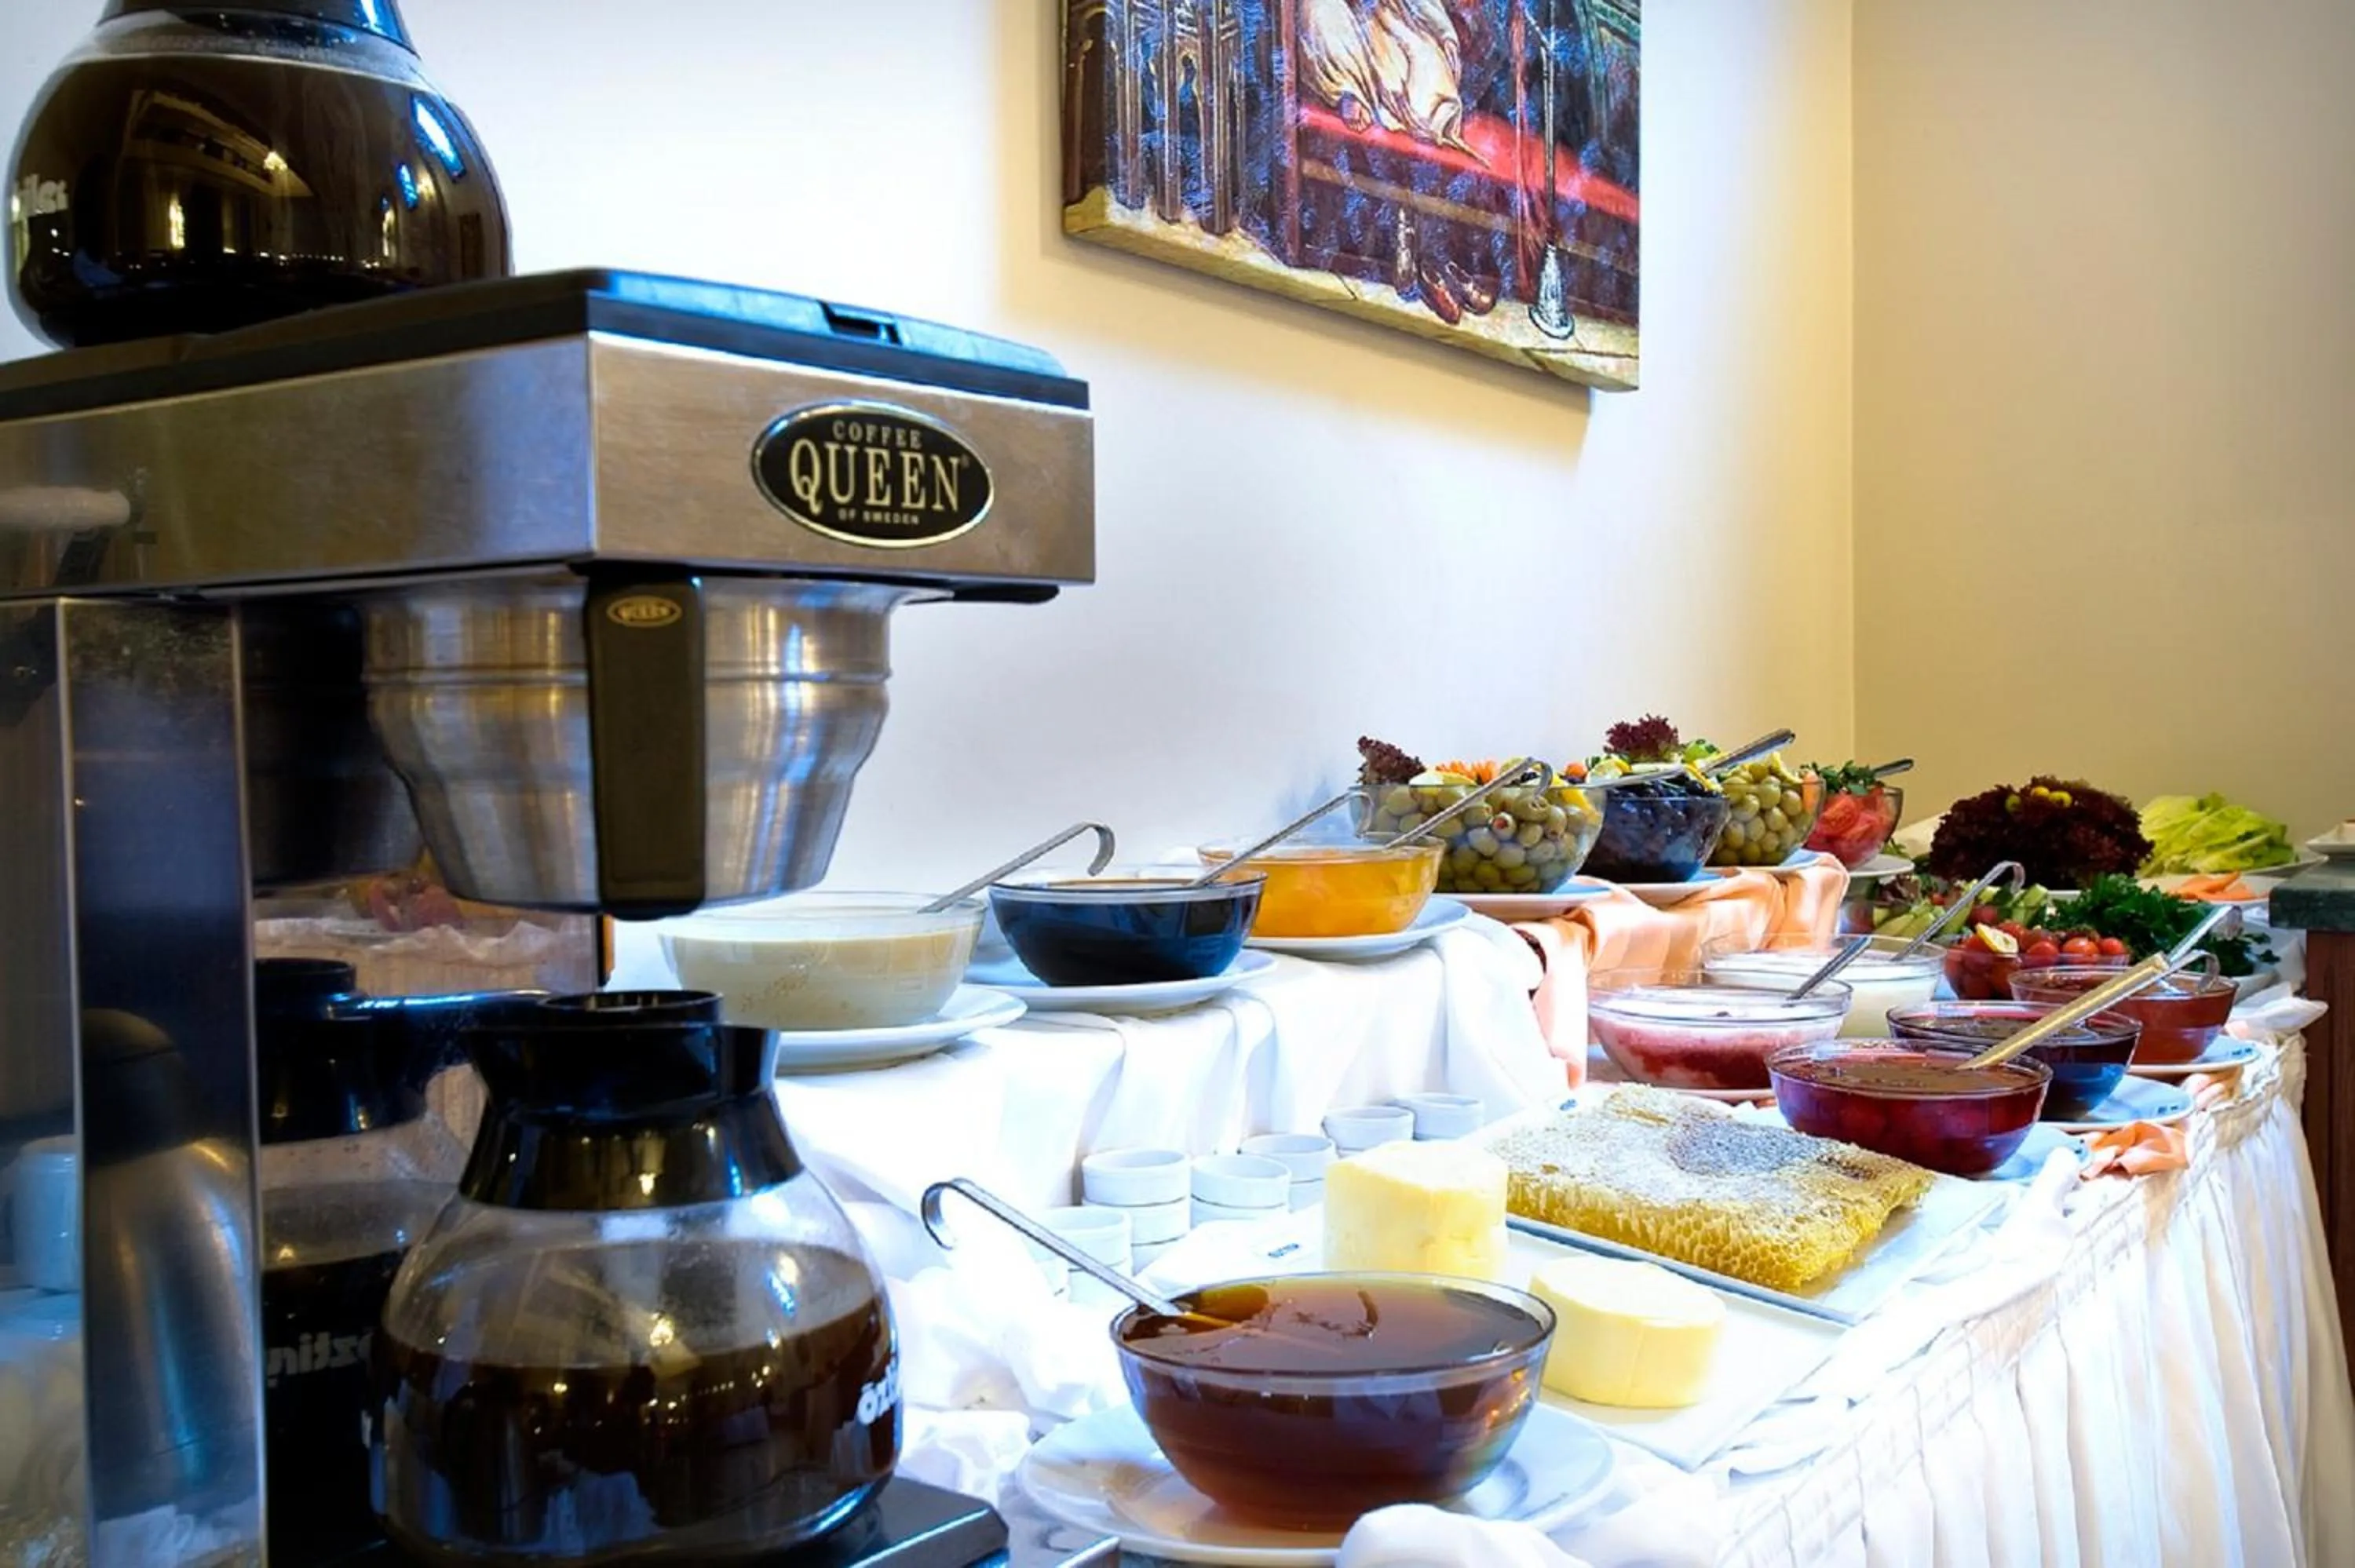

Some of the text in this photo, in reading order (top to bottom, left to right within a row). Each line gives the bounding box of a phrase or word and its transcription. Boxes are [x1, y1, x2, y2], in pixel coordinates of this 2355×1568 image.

[832, 419, 923, 450] COFFEE
[789, 438, 960, 515] QUEEN
[838, 508, 856, 522] OF
